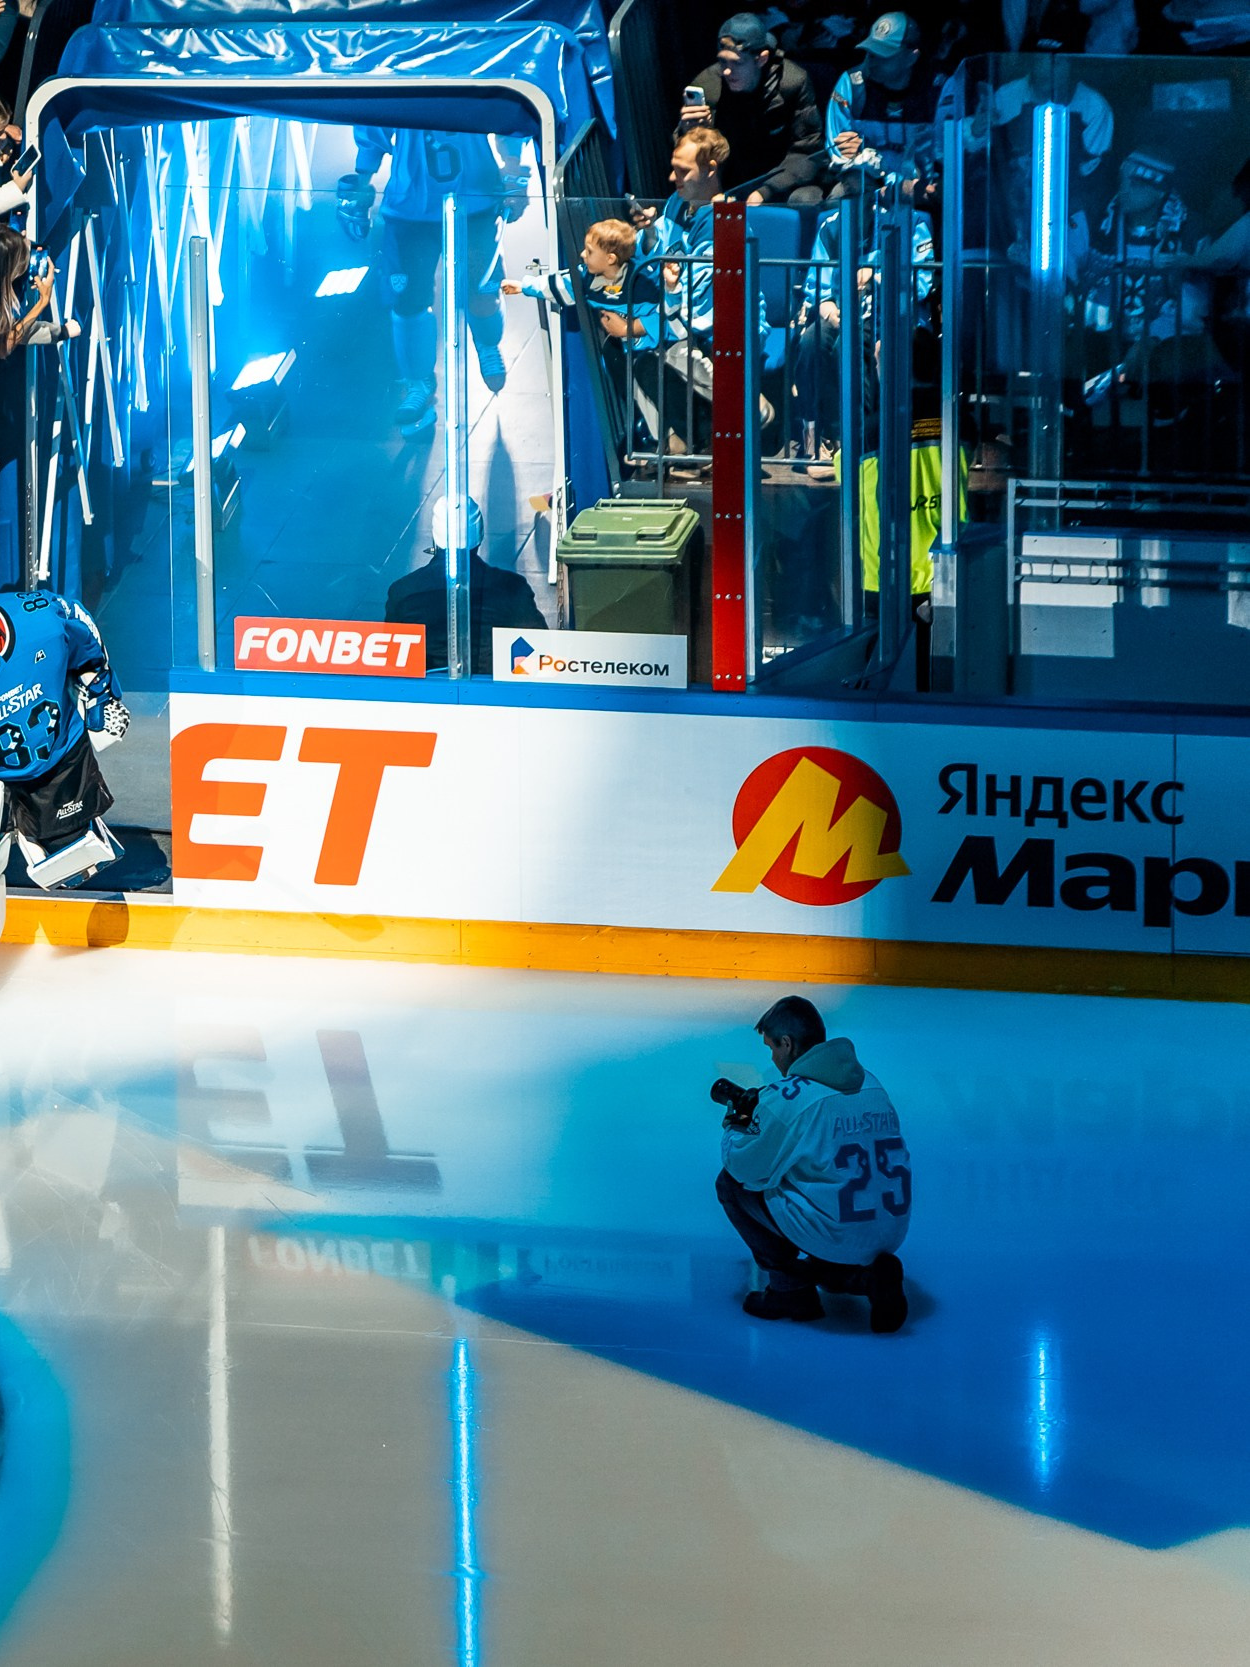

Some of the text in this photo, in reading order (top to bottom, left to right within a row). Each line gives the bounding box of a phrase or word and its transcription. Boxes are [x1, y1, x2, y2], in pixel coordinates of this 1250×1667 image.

[238, 627, 421, 668] FONBET
[539, 655, 669, 677] Ростелеком
[937, 762, 1185, 829] Яндекс
[833, 1134, 912, 1224] 25
